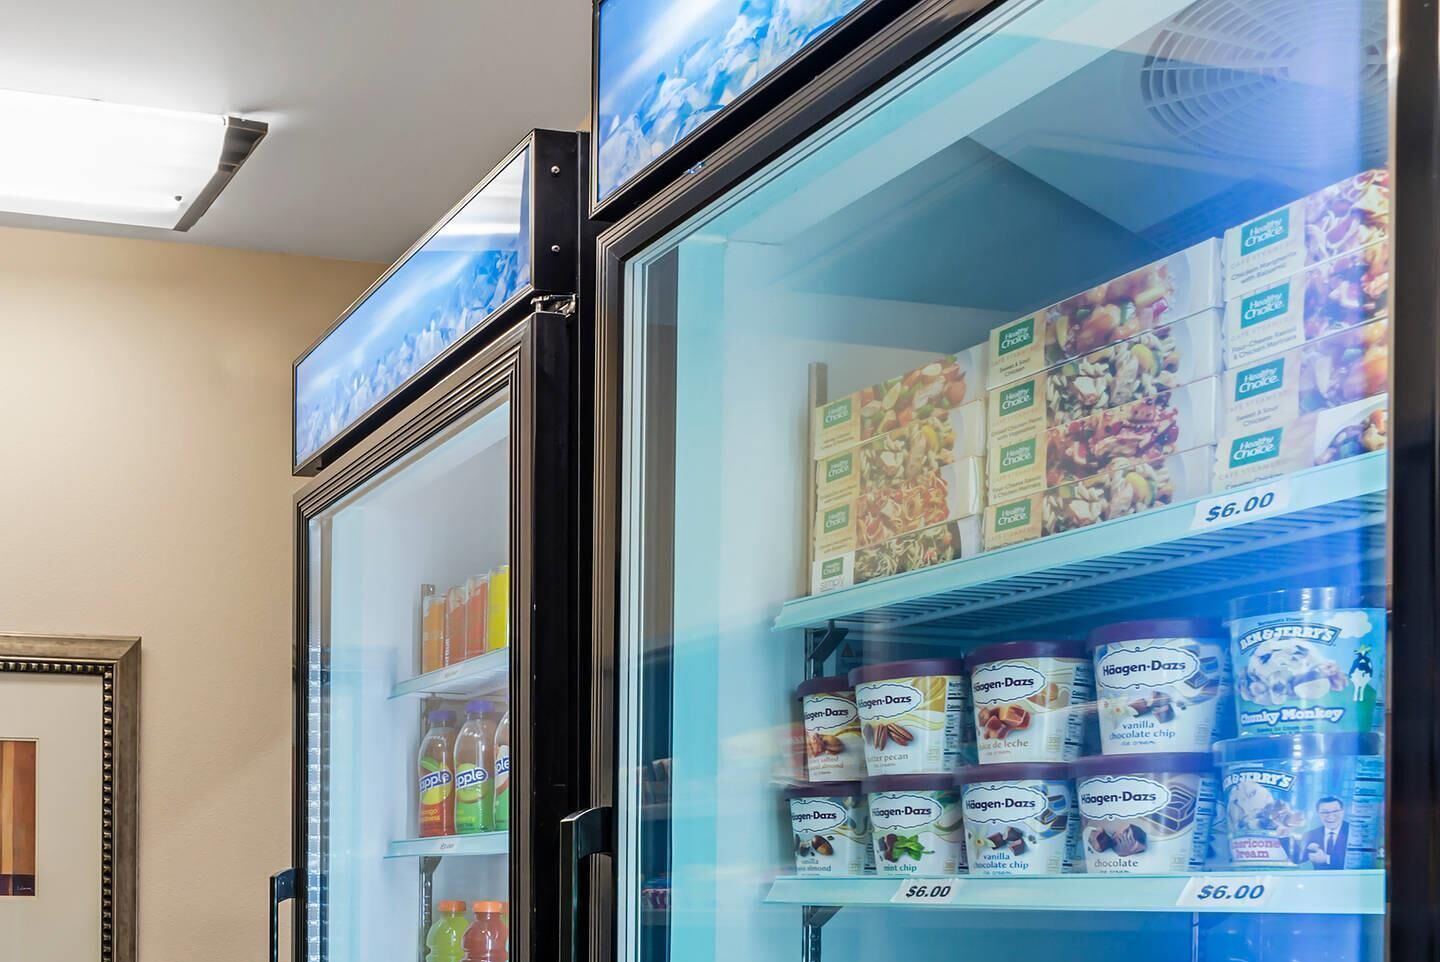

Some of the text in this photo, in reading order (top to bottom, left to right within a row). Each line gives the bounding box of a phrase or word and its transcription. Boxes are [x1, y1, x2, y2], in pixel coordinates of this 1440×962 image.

[1250, 218, 1283, 236] Healthy
[1245, 226, 1285, 247] Choice
[1250, 293, 1283, 309] Healthy
[1244, 301, 1285, 319] Choice
[1001, 333, 1030, 349] Choice
[1245, 368, 1277, 382] Healthy
[1239, 375, 1280, 393] Choice
[1233, 443, 1275, 460] Choice
[1240, 437, 1274, 450] Healthy
[1205, 492, 1275, 522] $6.00
[1273, 625, 1335, 642] JERRY'S
[1281, 705, 1345, 723] Monkey
[1122, 721, 1155, 730] vanilla
[1153, 729, 1176, 739] chip
[1004, 738, 1029, 748] leche
[884, 752, 909, 765] pecan
[420, 771, 450, 791] apple
[456, 769, 485, 789] pple
[984, 853, 1010, 861] vanilla
[1009, 860, 1029, 870] chip
[899, 863, 917, 874] chip
[906, 885, 951, 899] $6.00
[1197, 883, 1265, 901] $6.00
